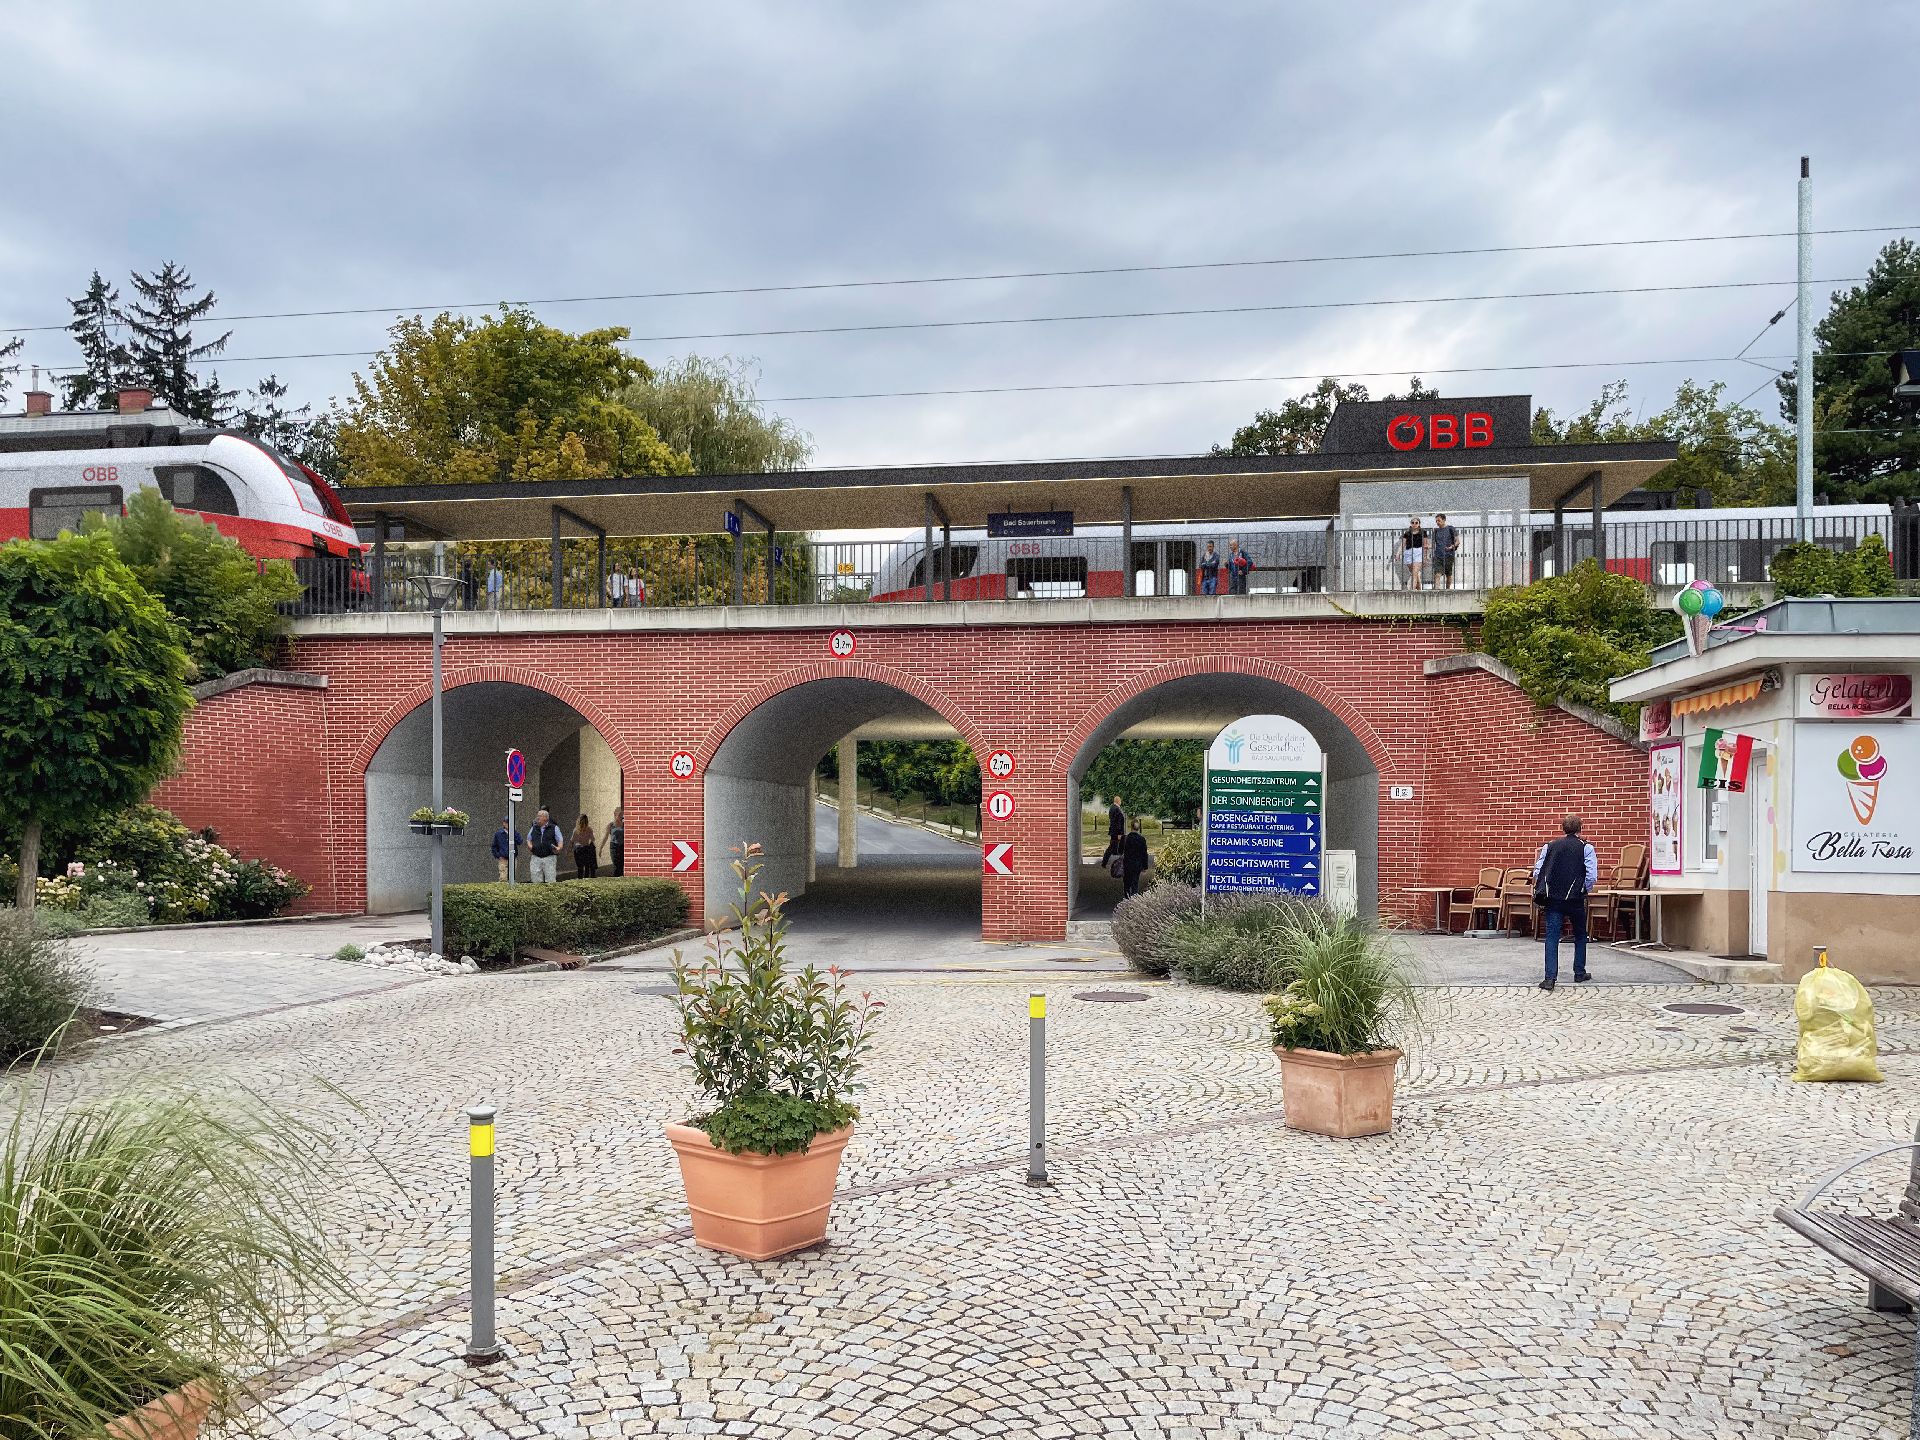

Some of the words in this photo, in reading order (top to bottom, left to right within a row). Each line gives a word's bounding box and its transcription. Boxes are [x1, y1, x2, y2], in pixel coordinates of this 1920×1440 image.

[1387, 412, 1494, 450] ÖBB
[1249, 741, 1305, 752] Gesundheit
[675, 760, 691, 771] 2,7m
[991, 759, 1009, 770] 2,7m
[1211, 776, 1297, 786] GESUNDHEITSZENTRUM
[1703, 777, 1743, 790] EIS
[1211, 796, 1228, 805] DER
[1230, 796, 1296, 807] SONNBERGHOF
[1211, 813, 1277, 823] ROSENGARTEN
[1210, 837, 1250, 846] KERAMIK
[1251, 838, 1284, 847] SABINE
[1806, 831, 1867, 861] Bella
[1872, 840, 1914, 859] Rosa
[1210, 858, 1290, 869] AUSSICHTSWARTE
[1209, 875, 1240, 884] TEXTIL
[1241, 876, 1275, 885] EBERTH
